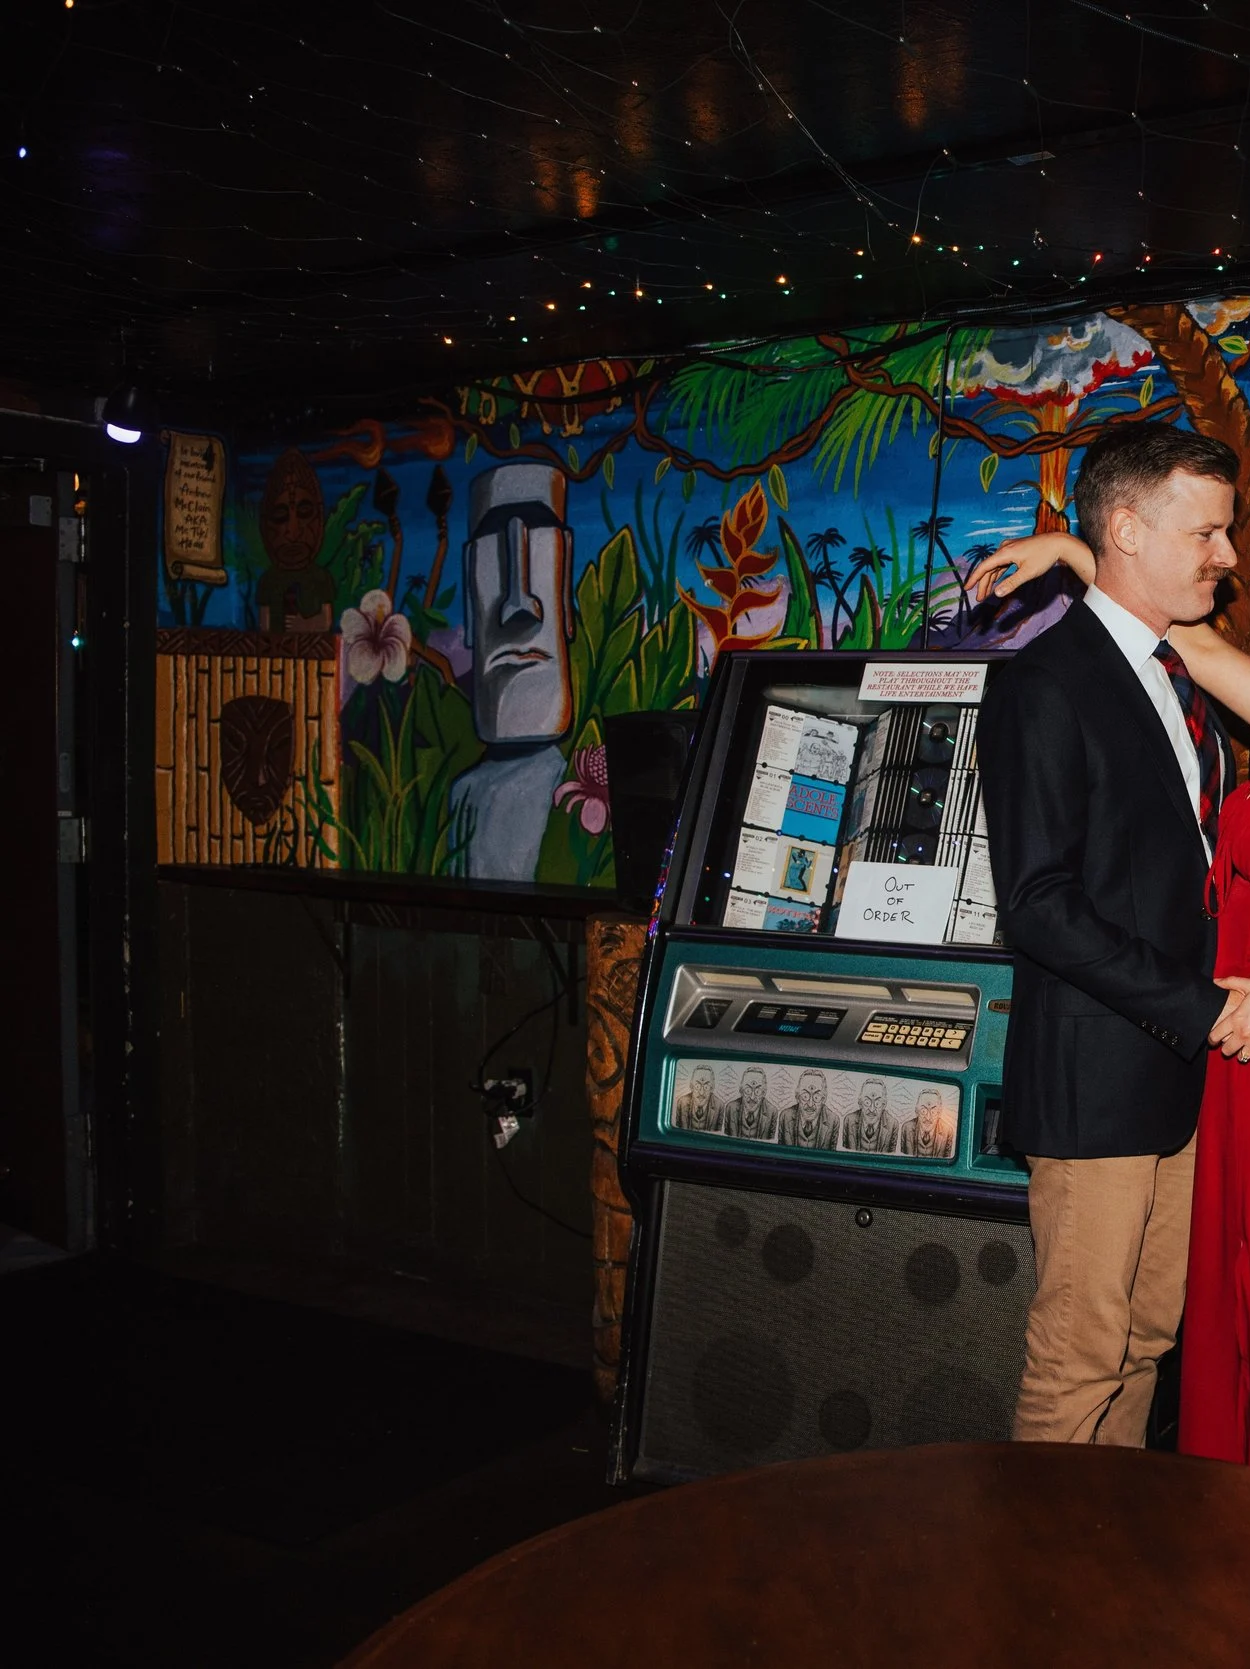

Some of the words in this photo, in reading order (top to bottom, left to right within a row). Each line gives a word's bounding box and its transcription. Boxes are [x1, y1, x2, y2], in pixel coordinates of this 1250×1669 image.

[184, 514, 208, 525] AKA
[786, 797, 840, 818] SCENTS
[884, 876, 915, 892] OUT
[886, 896, 904, 906] OF
[863, 906, 915, 924] ORDER
